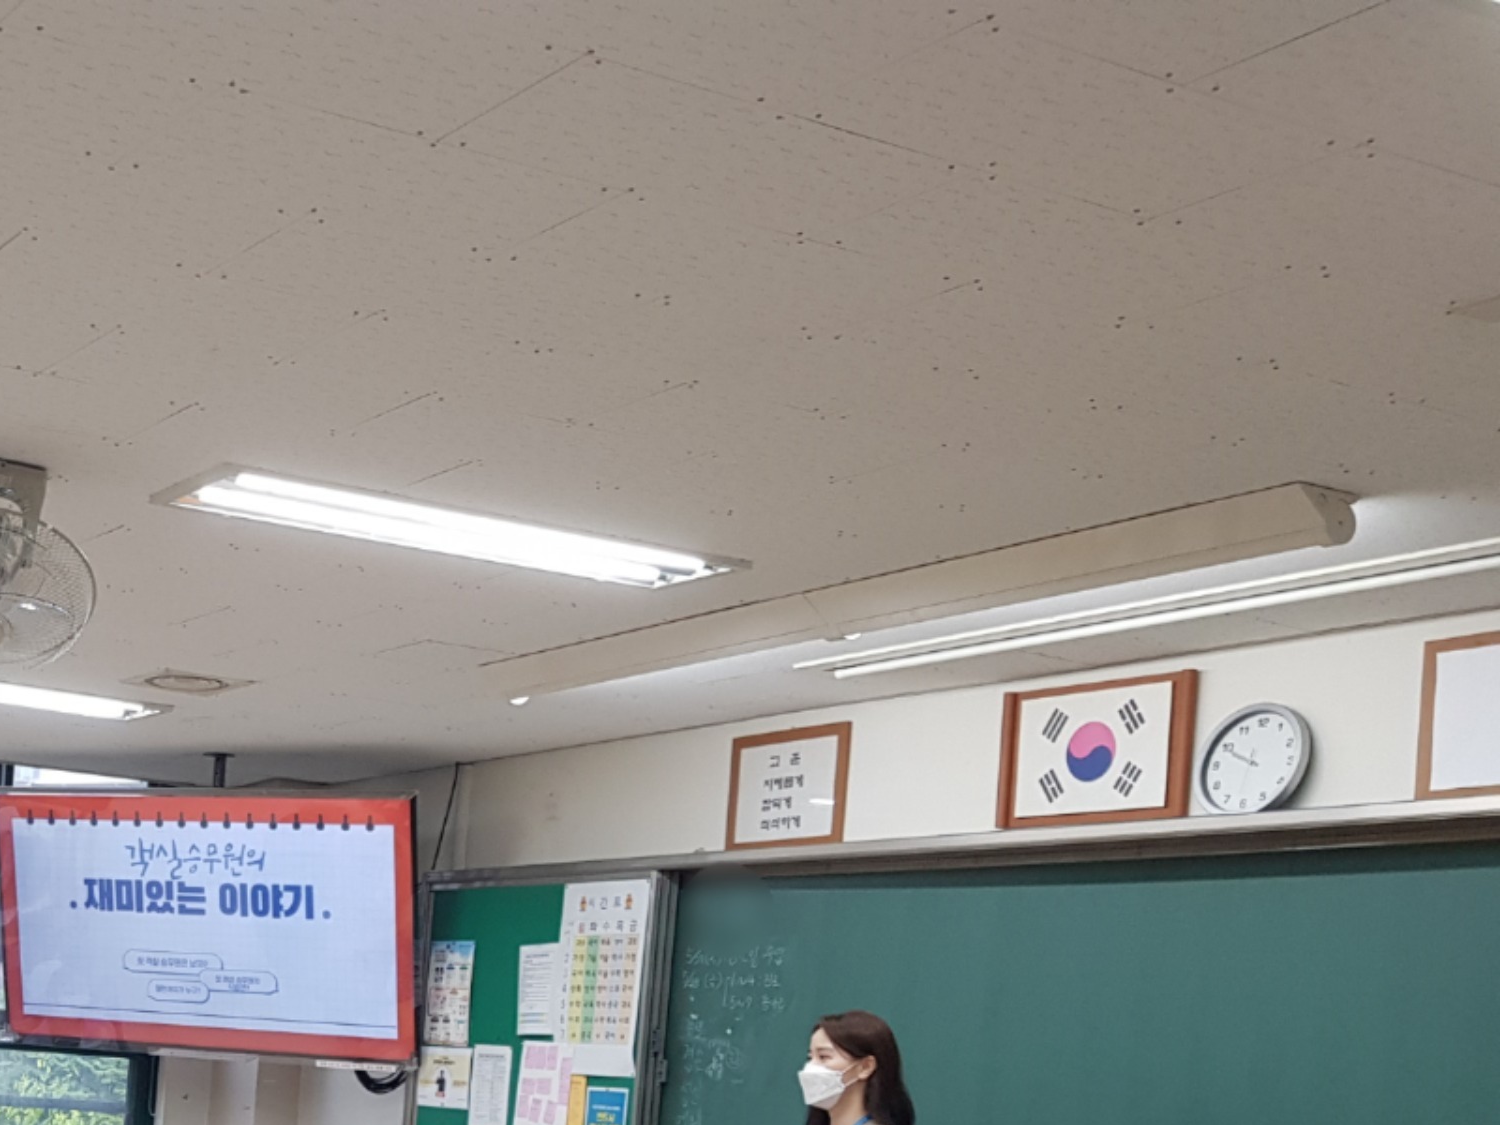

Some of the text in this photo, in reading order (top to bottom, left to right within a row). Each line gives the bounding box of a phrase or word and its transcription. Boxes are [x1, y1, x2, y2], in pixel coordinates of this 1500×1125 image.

[124, 837, 266, 880] 객실승무원의
[84, 878, 314, 920] 재미있는 이야기
